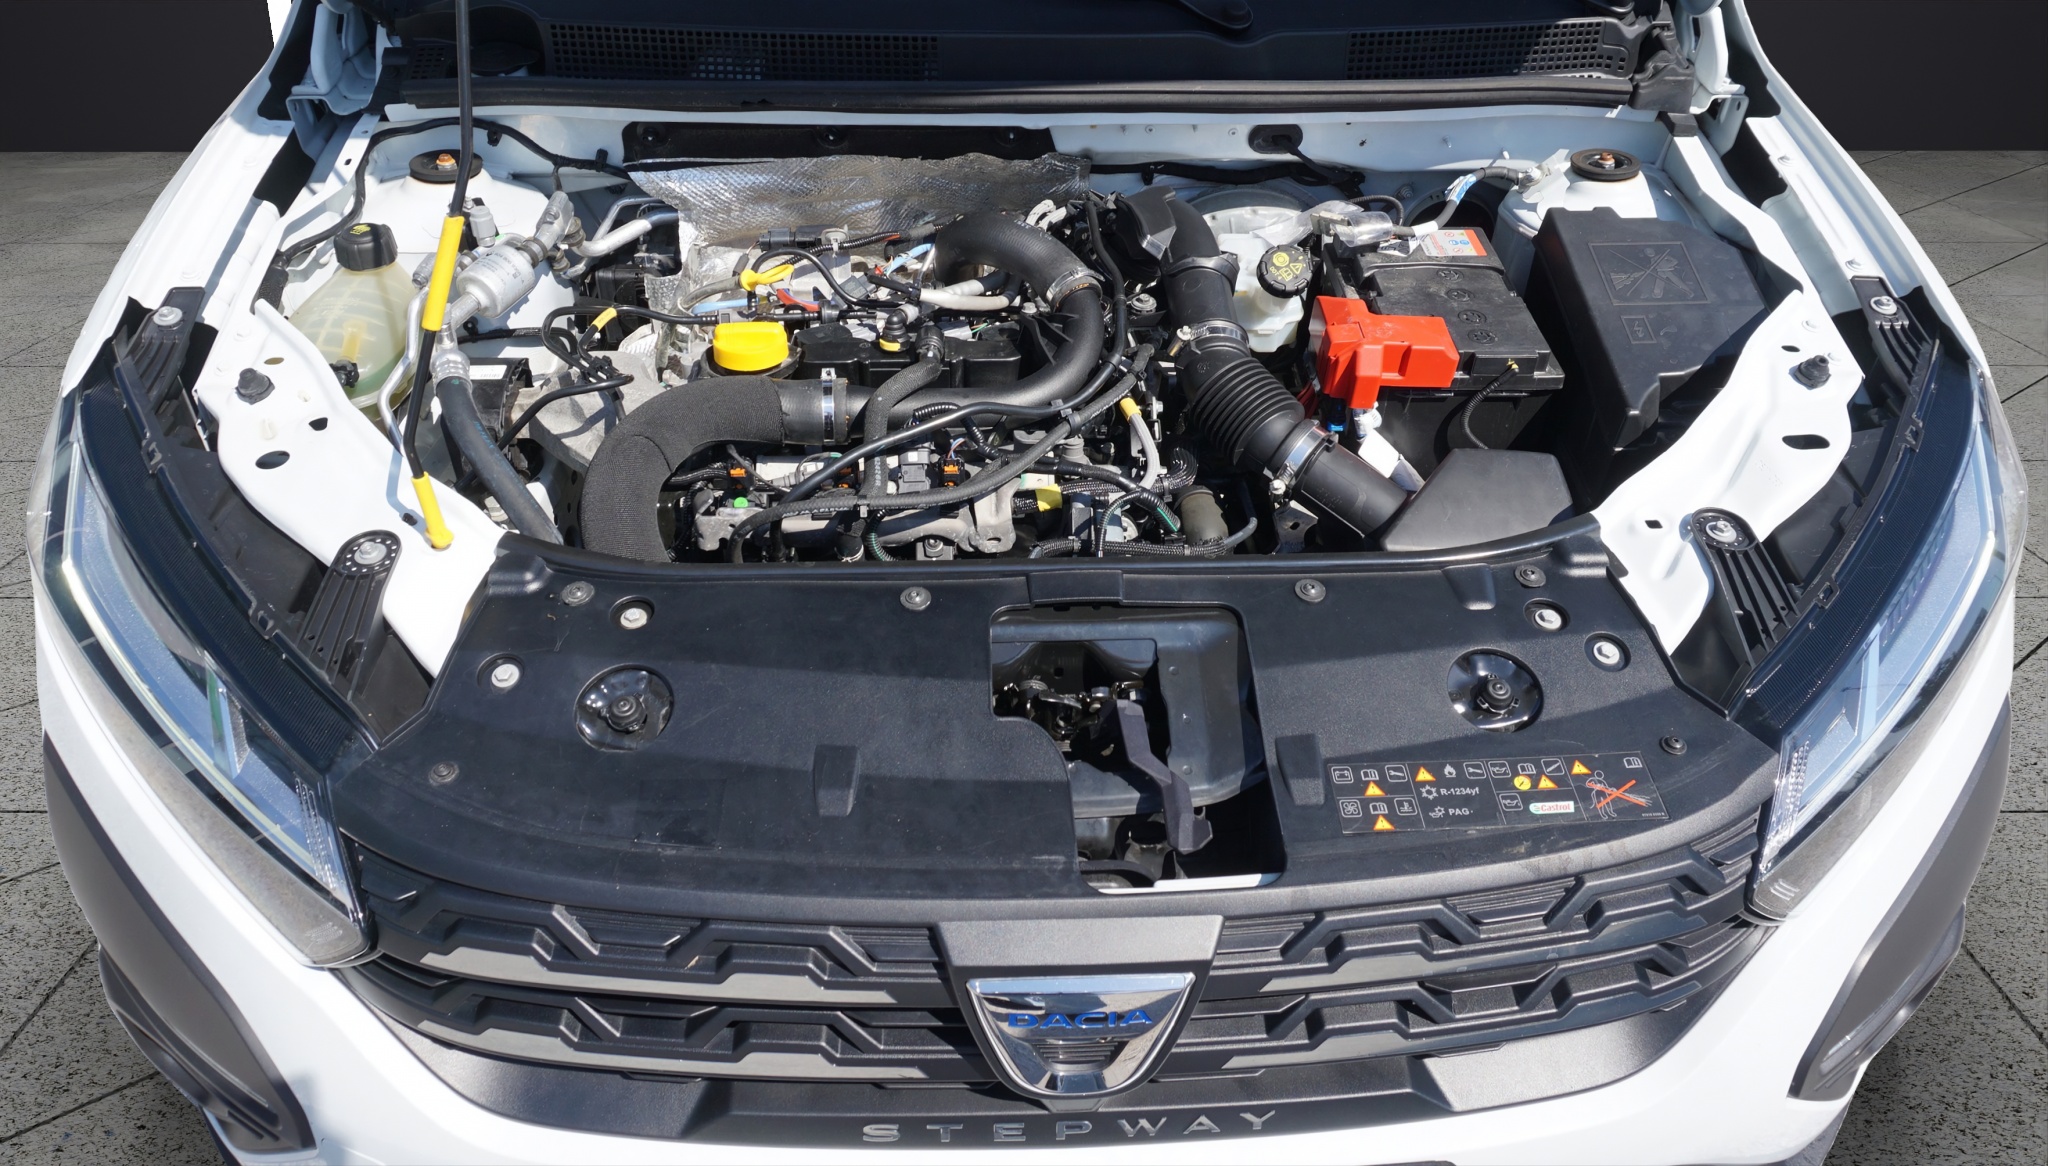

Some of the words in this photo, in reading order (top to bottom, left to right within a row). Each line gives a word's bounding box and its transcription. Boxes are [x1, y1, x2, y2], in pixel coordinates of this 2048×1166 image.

[1440, 786, 1480, 797] R-1234yf
[1540, 802, 1572, 813] Castrol
[1007, 1009, 1153, 1029] DACIA
[862, 1110, 1276, 1143] STEPWAY
